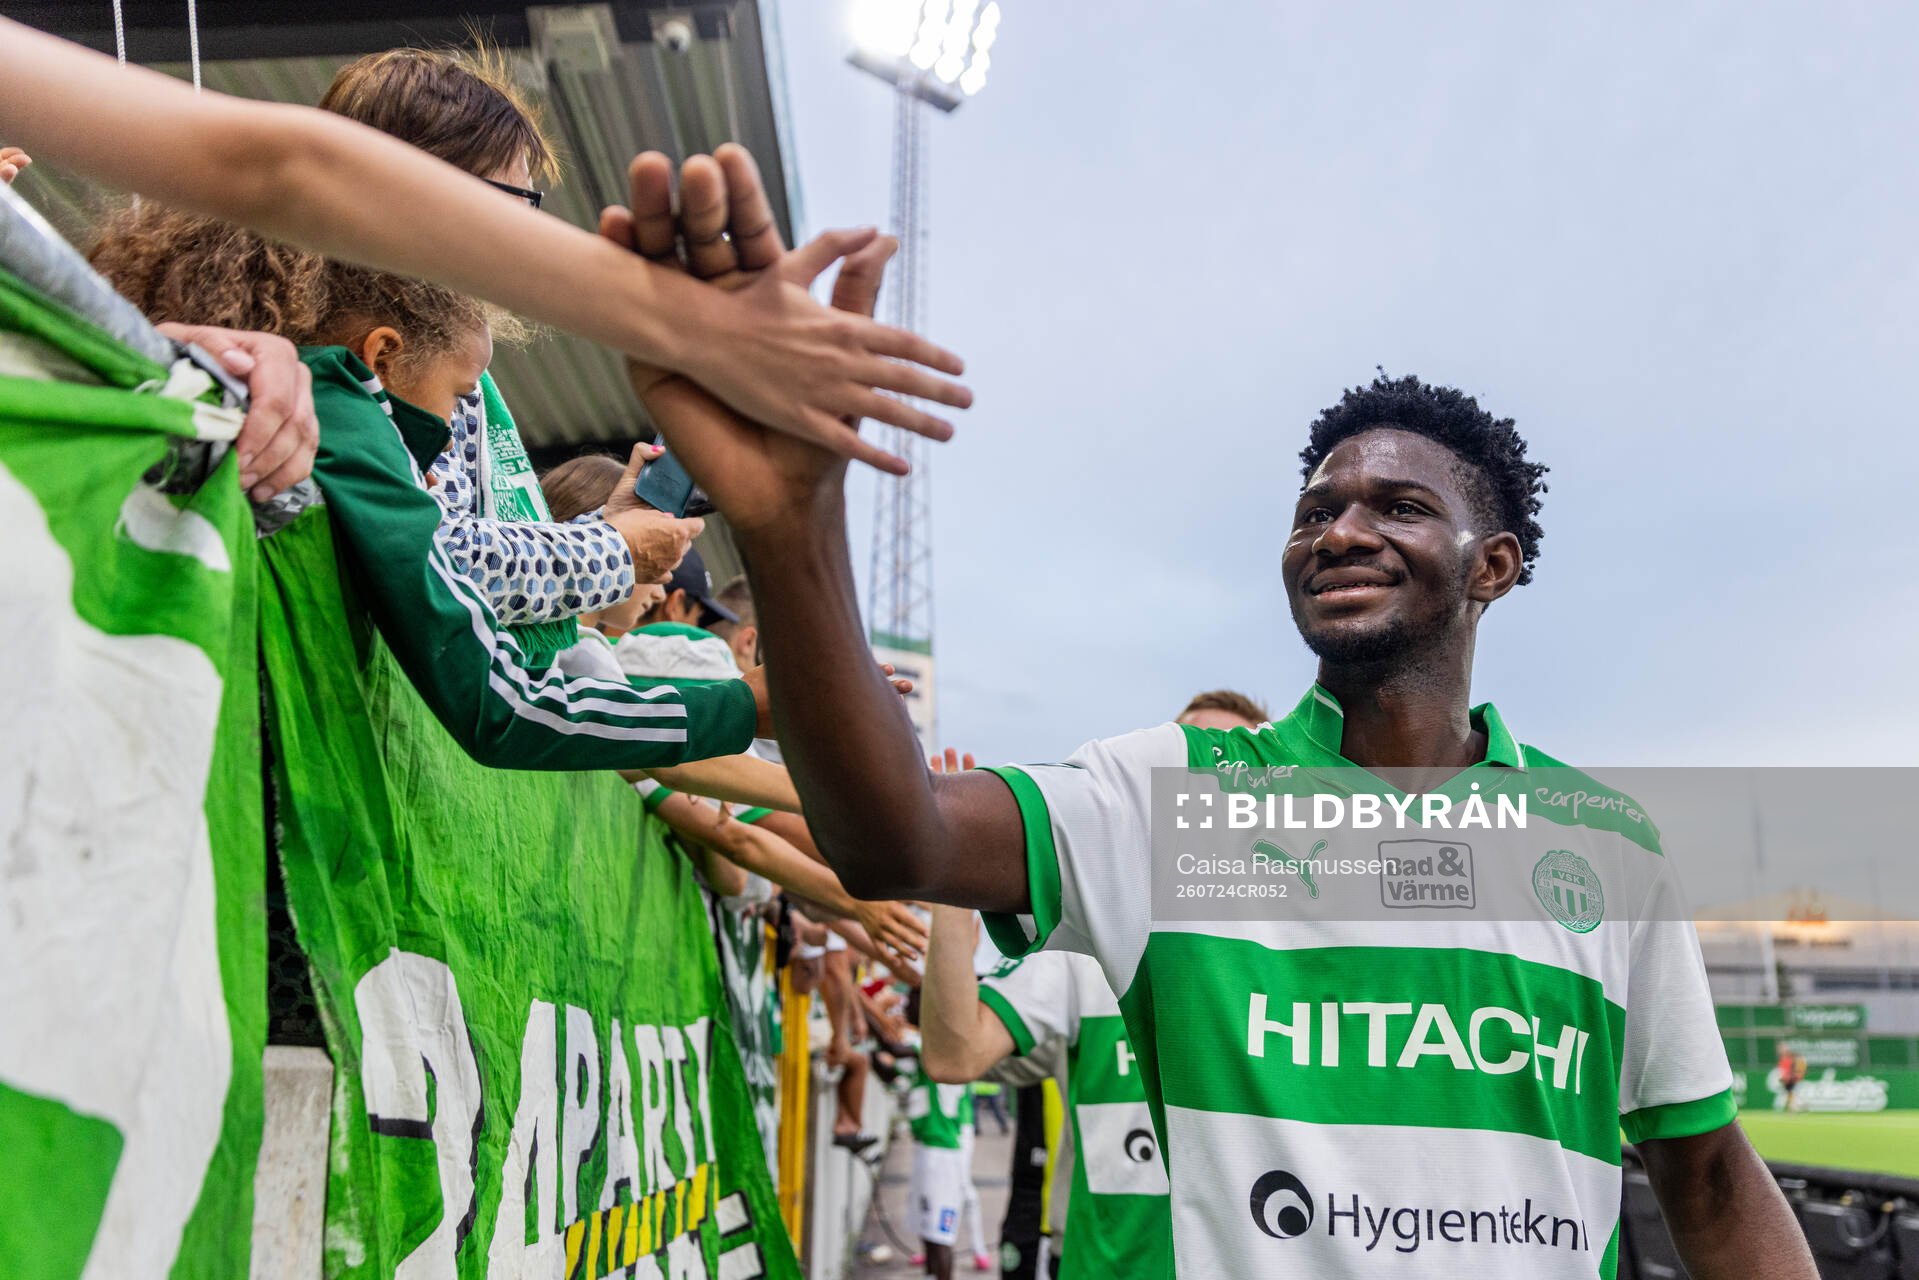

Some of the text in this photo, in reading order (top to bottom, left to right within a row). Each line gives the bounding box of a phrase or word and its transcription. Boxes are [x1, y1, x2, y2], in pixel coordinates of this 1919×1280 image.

[503, 457, 531, 474] SK
[1386, 846, 1468, 878] Bad &
[1557, 870, 1581, 885] VSK
[1387, 879, 1470, 901] Värme
[1247, 993, 1590, 1094] HITACHI
